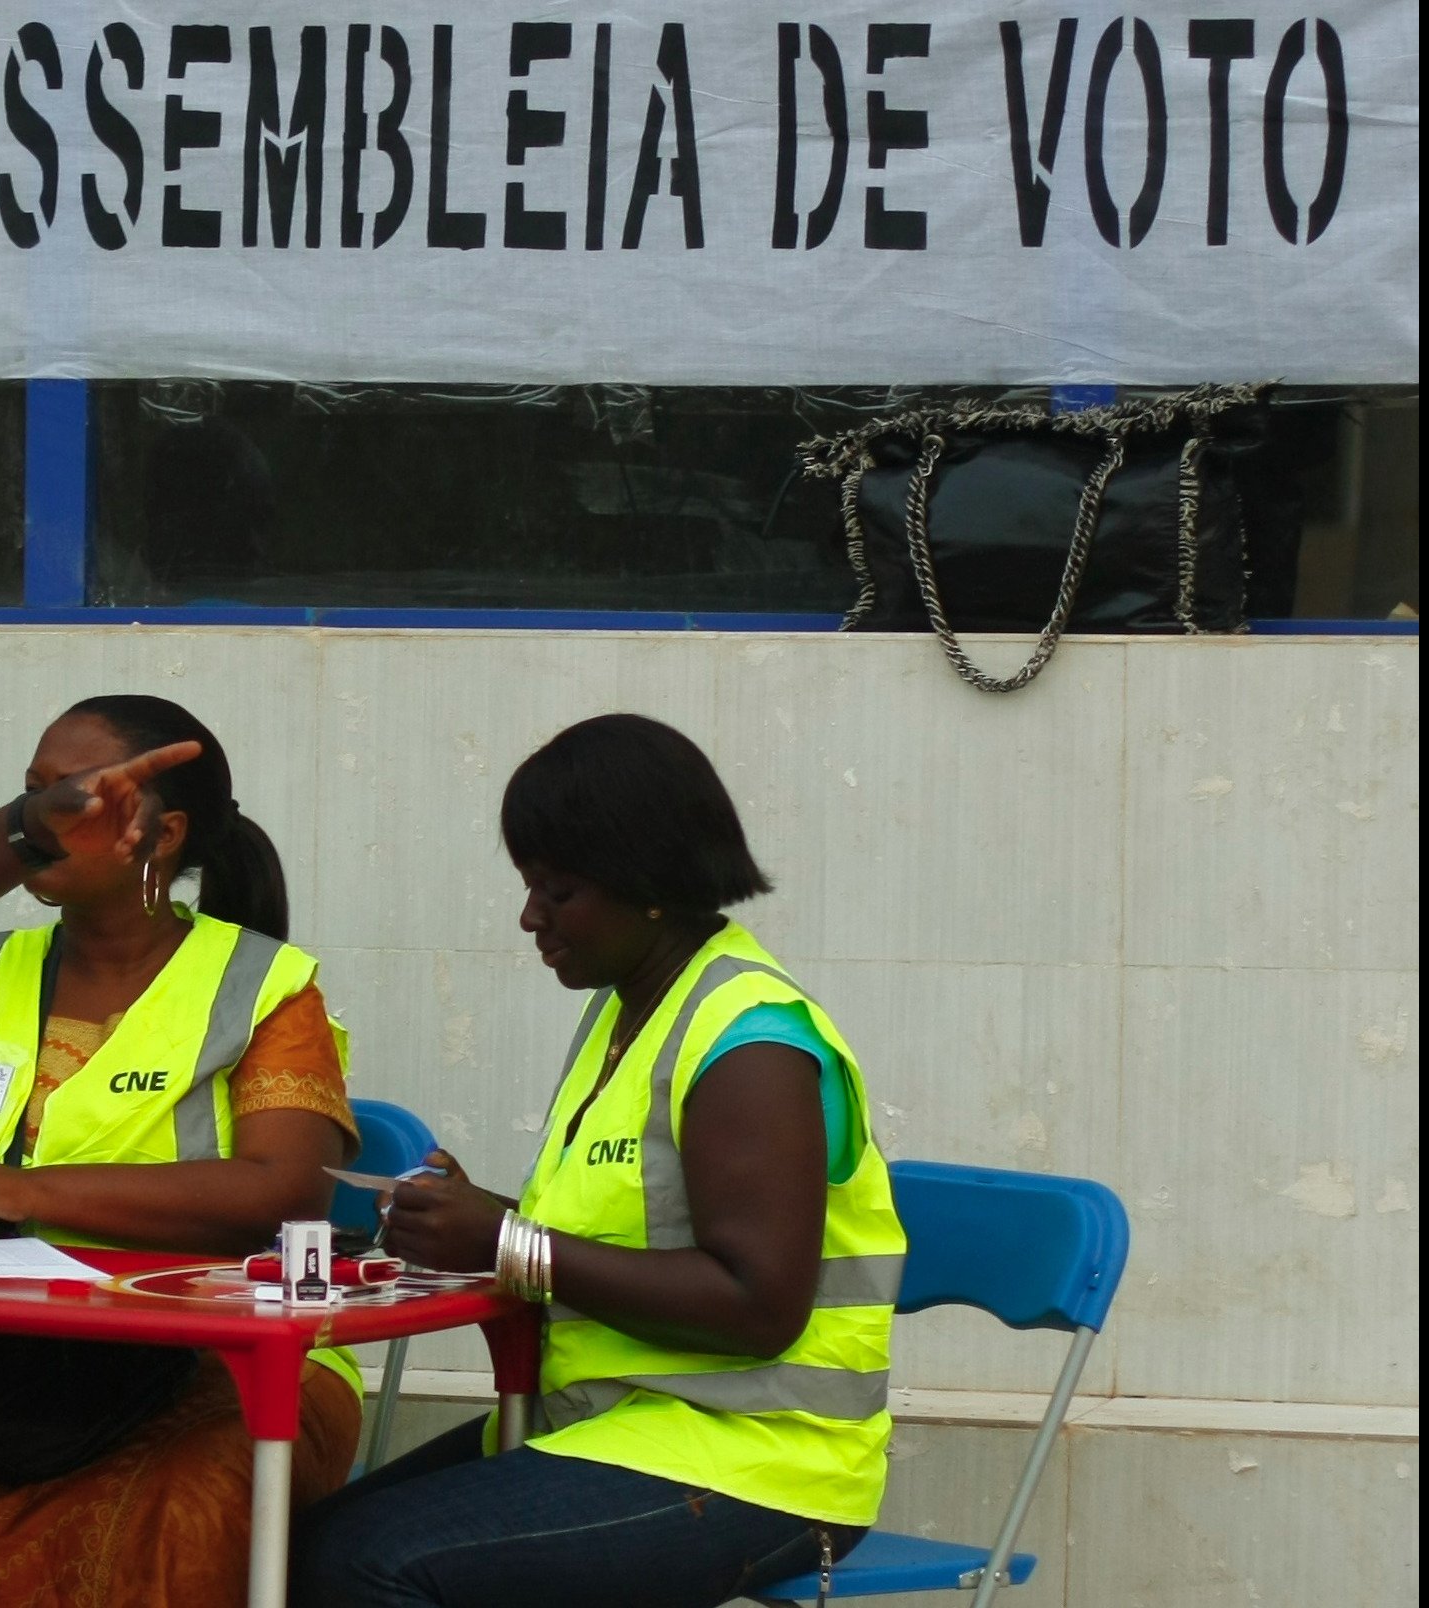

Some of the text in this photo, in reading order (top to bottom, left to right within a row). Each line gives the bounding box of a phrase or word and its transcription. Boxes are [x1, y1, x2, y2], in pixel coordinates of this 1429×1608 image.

[772, 23, 931, 250] DE
[999, 16, 1348, 249] VOTO
[109, 1070, 169, 1093] CNE
[587, 1138, 637, 1166] CNE
